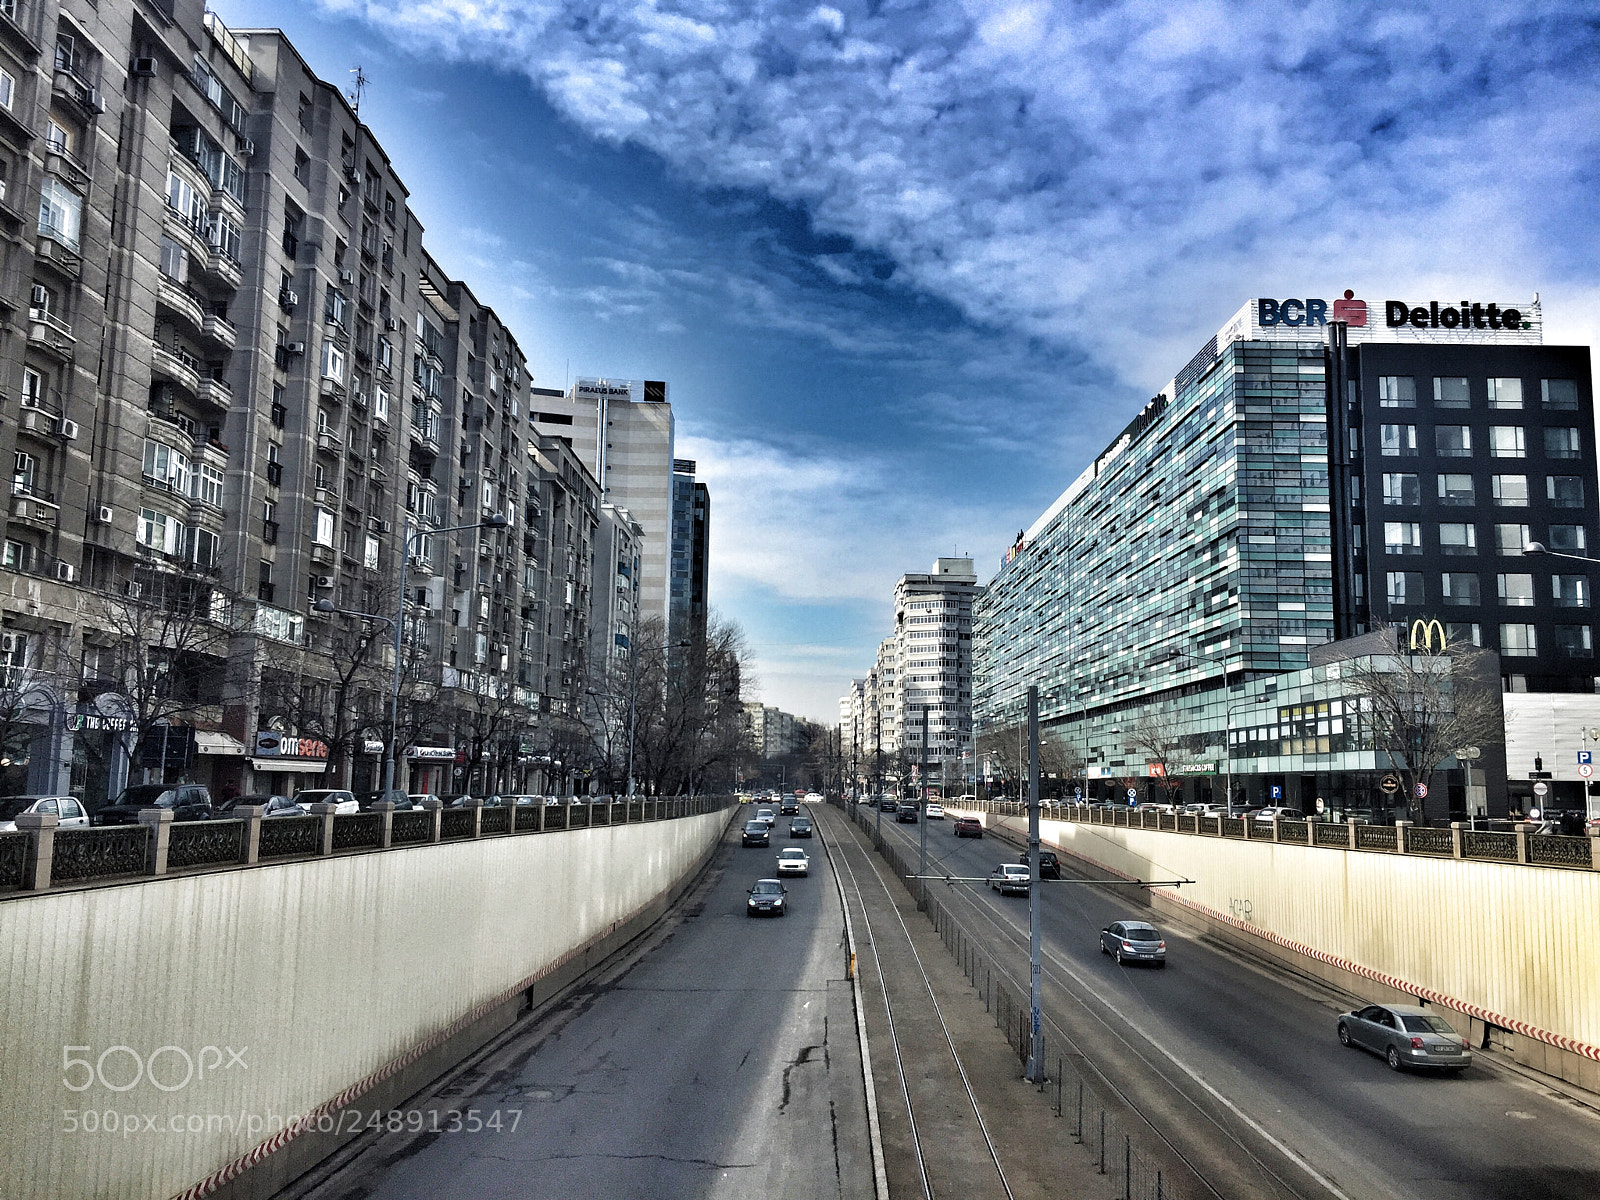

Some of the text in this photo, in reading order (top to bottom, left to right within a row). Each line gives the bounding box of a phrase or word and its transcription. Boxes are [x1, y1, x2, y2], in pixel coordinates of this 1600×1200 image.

[1258, 298, 1328, 327] BCR
[1385, 300, 1531, 330] Deloitte.
[579, 386, 629, 396] PIRAEUS BANK
[86, 715, 100, 730] THE
[1579, 752, 1590, 763] P
